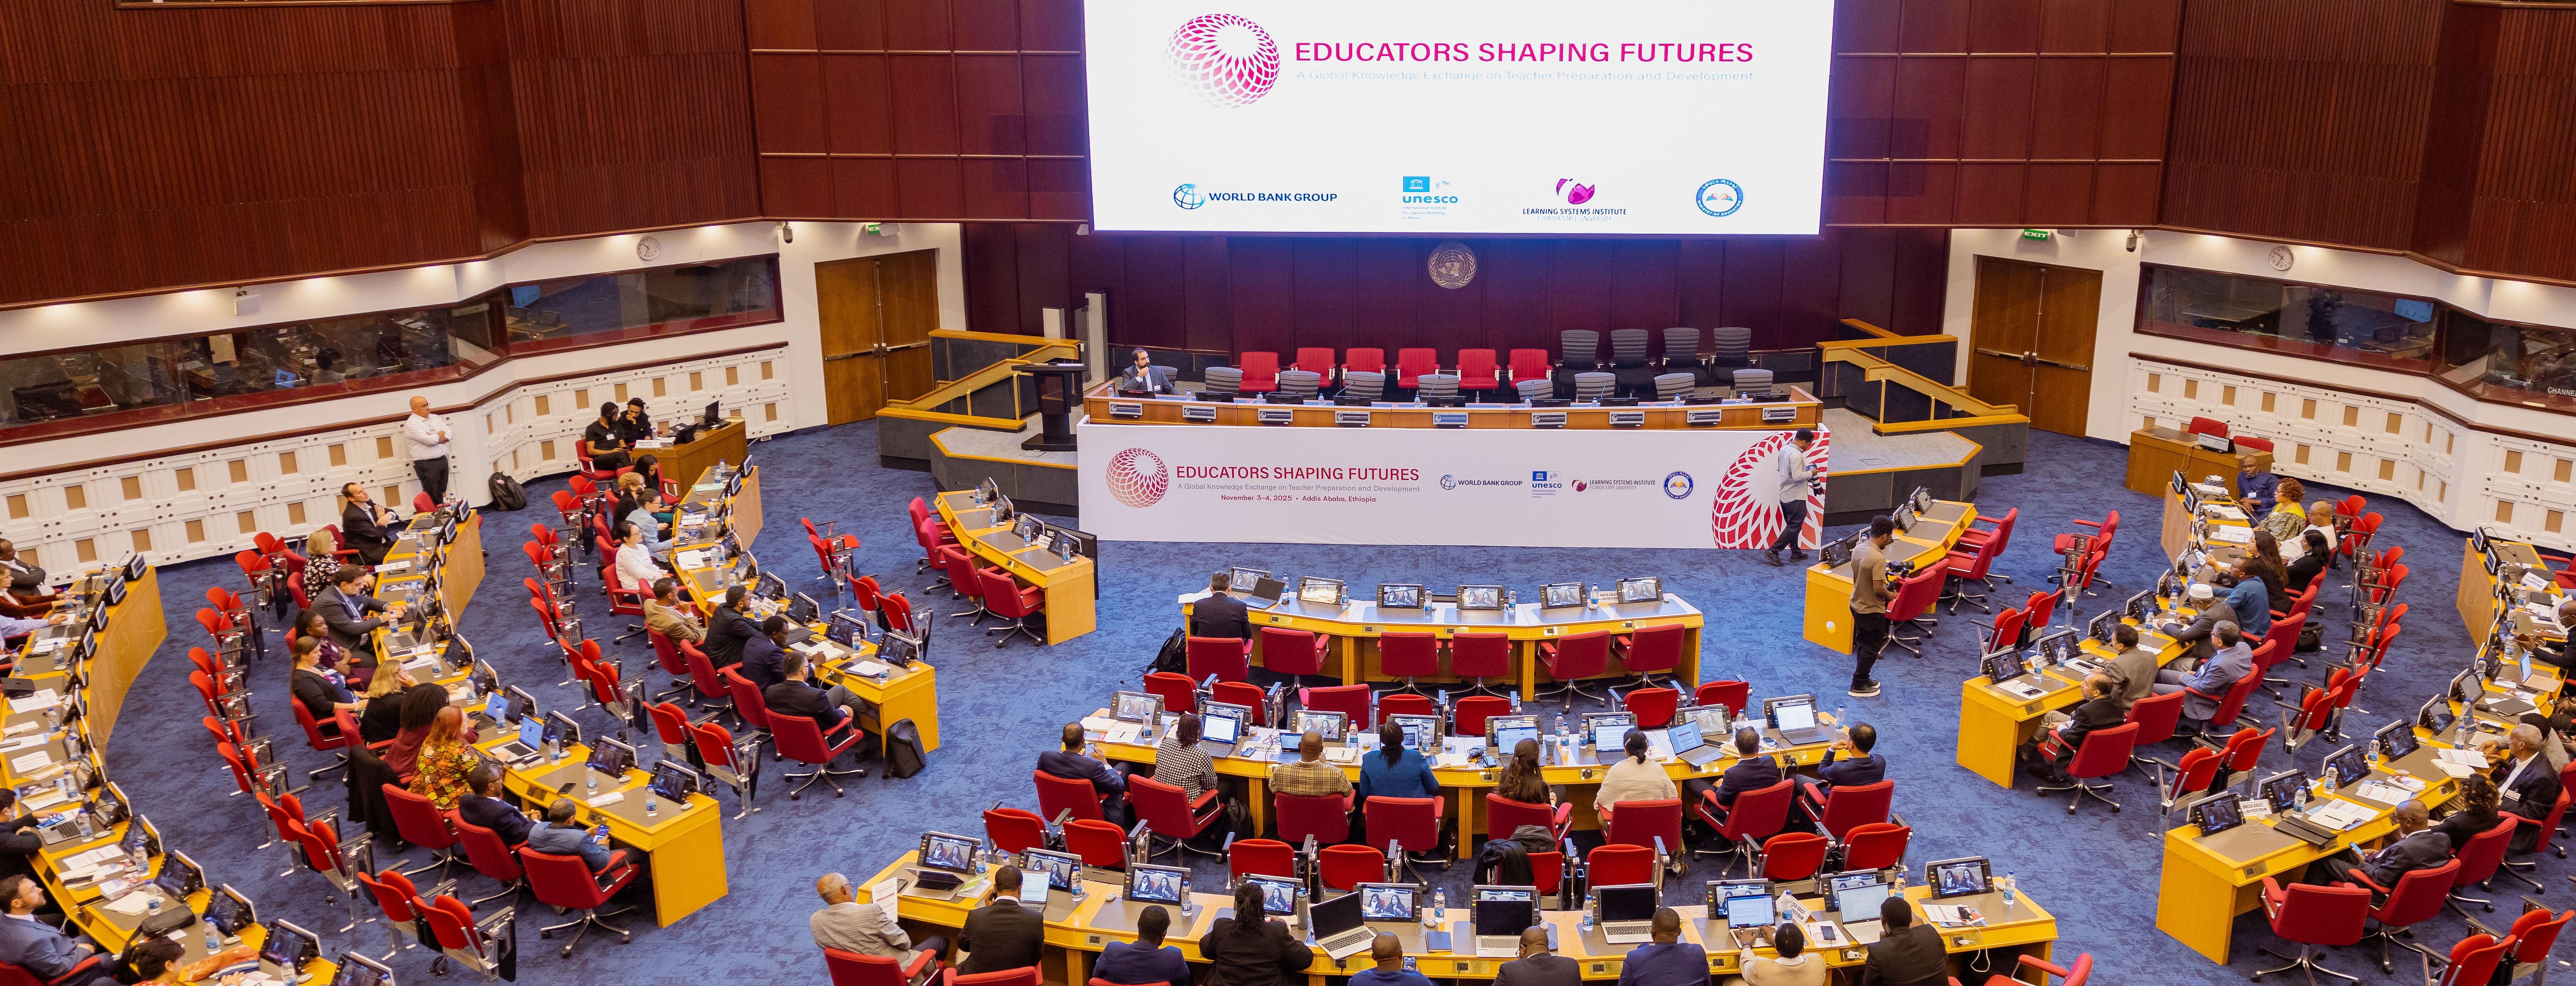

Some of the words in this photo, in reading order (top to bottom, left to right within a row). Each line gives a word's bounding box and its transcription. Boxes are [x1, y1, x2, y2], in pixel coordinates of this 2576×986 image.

[1296, 43, 1469, 62] EDUCATORS
[1479, 43, 1608, 62] SHAPING
[1621, 43, 1753, 62] FUTURES
[1297, 71, 1305, 79] A
[1309, 71, 1347, 79] Global
[1352, 71, 1419, 82] Knowledge
[1423, 71, 1483, 82] Exchange
[1506, 71, 1552, 80] Teacher
[1557, 71, 1632, 82] Preparation
[1638, 71, 1661, 80] and
[1667, 71, 1753, 82] Development
[1209, 193, 1255, 201] WORLD
[1258, 193, 1292, 201] BANK
[1294, 193, 1337, 202] GROUP
[1176, 466, 1269, 479] EDUCATORS
[1273, 466, 1343, 480] SHAPING
[1348, 468, 1419, 481] FUTURES
[1680, 487, 1692, 498] EDUCATION
[1797, 906, 1806, 915] GUEST
